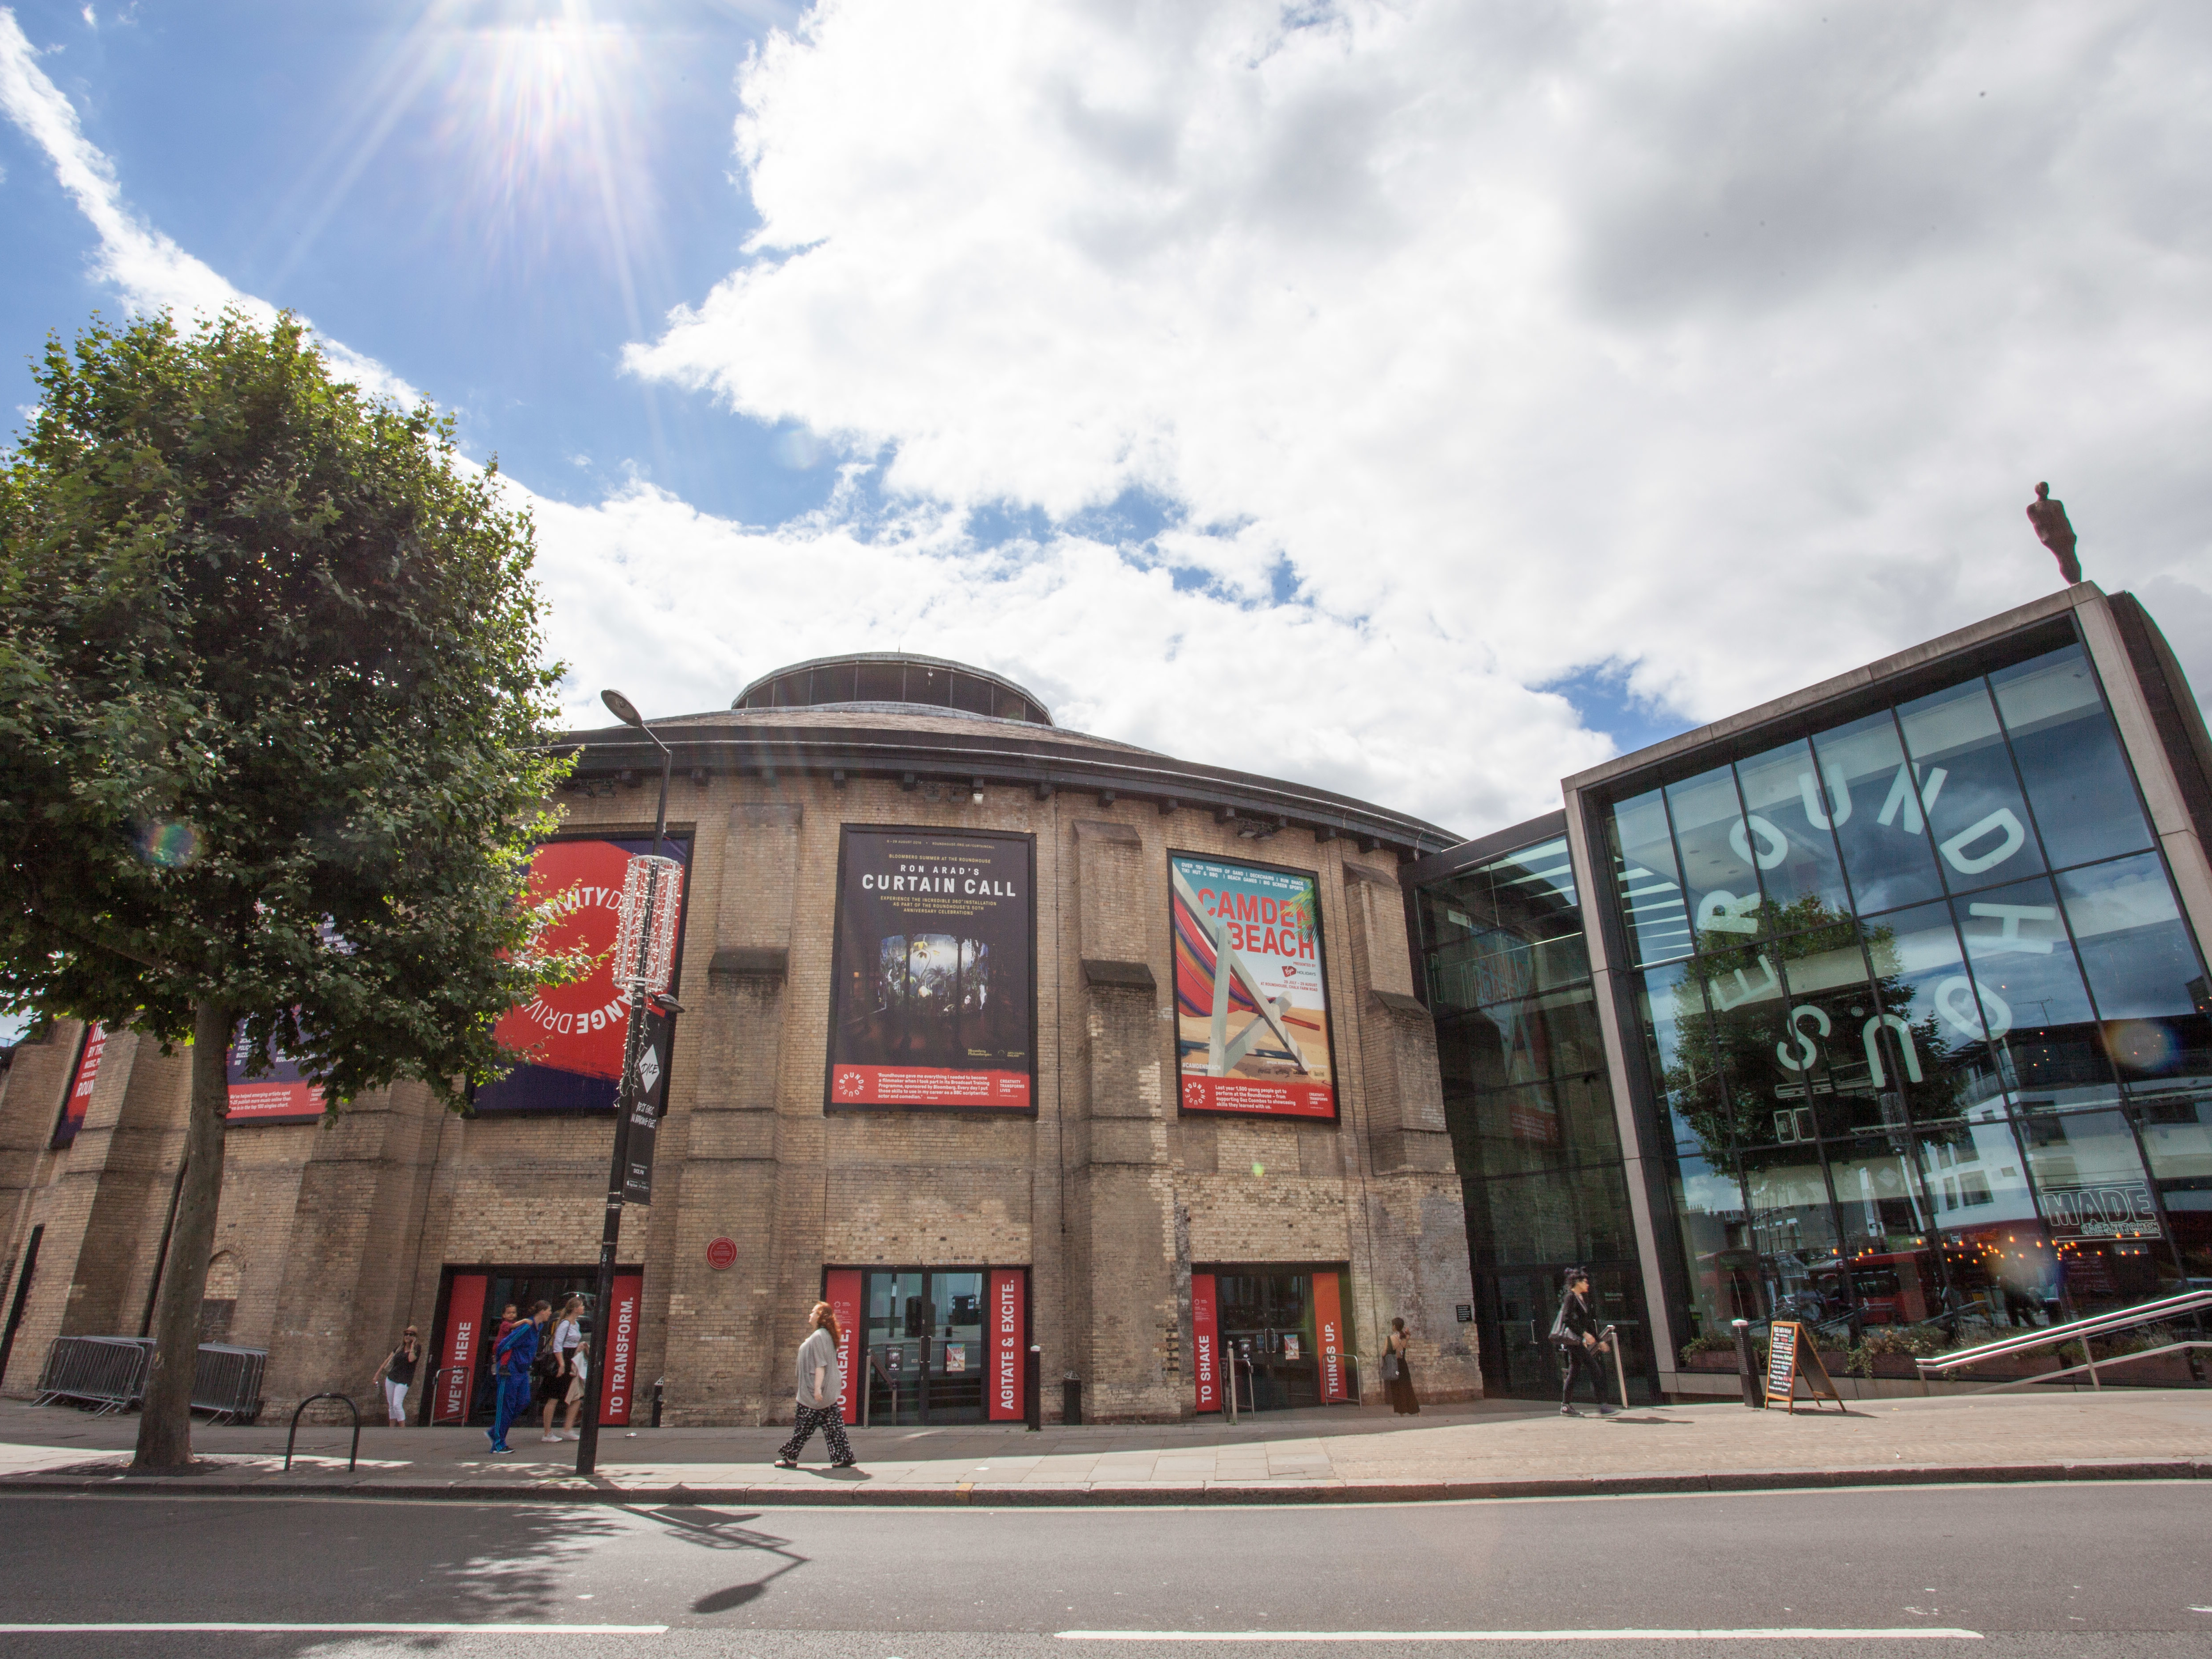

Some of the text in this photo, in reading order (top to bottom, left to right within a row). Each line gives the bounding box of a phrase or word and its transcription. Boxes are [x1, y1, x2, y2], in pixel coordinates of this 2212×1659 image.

[862, 874, 1016, 897] CURTAIN CALL
[933, 867, 979, 876] ARAD'S
[1197, 888, 1312, 930] CAMDEN
[1697, 762, 2056, 1088] ROUNDHOUSE
[1227, 921, 1315, 960] BEACH
[641, 1063, 659, 1075] DICE
[839, 1072, 864, 1097] ROUNDHOUSE
[1185, 1082, 1205, 1105] ROUNDHOUSE
[2043, 1188, 2156, 1226] MADE
[610, 1297, 634, 1415] TO TRANSFORM.
[1001, 1280, 1014, 1410] AGITATE & EXCITE.
[1324, 1322, 1339, 1394] THINGS UP.
[447, 1322, 471, 1413] WE'RE HERE
[1199, 1336, 1212, 1403] TO SHAKE
